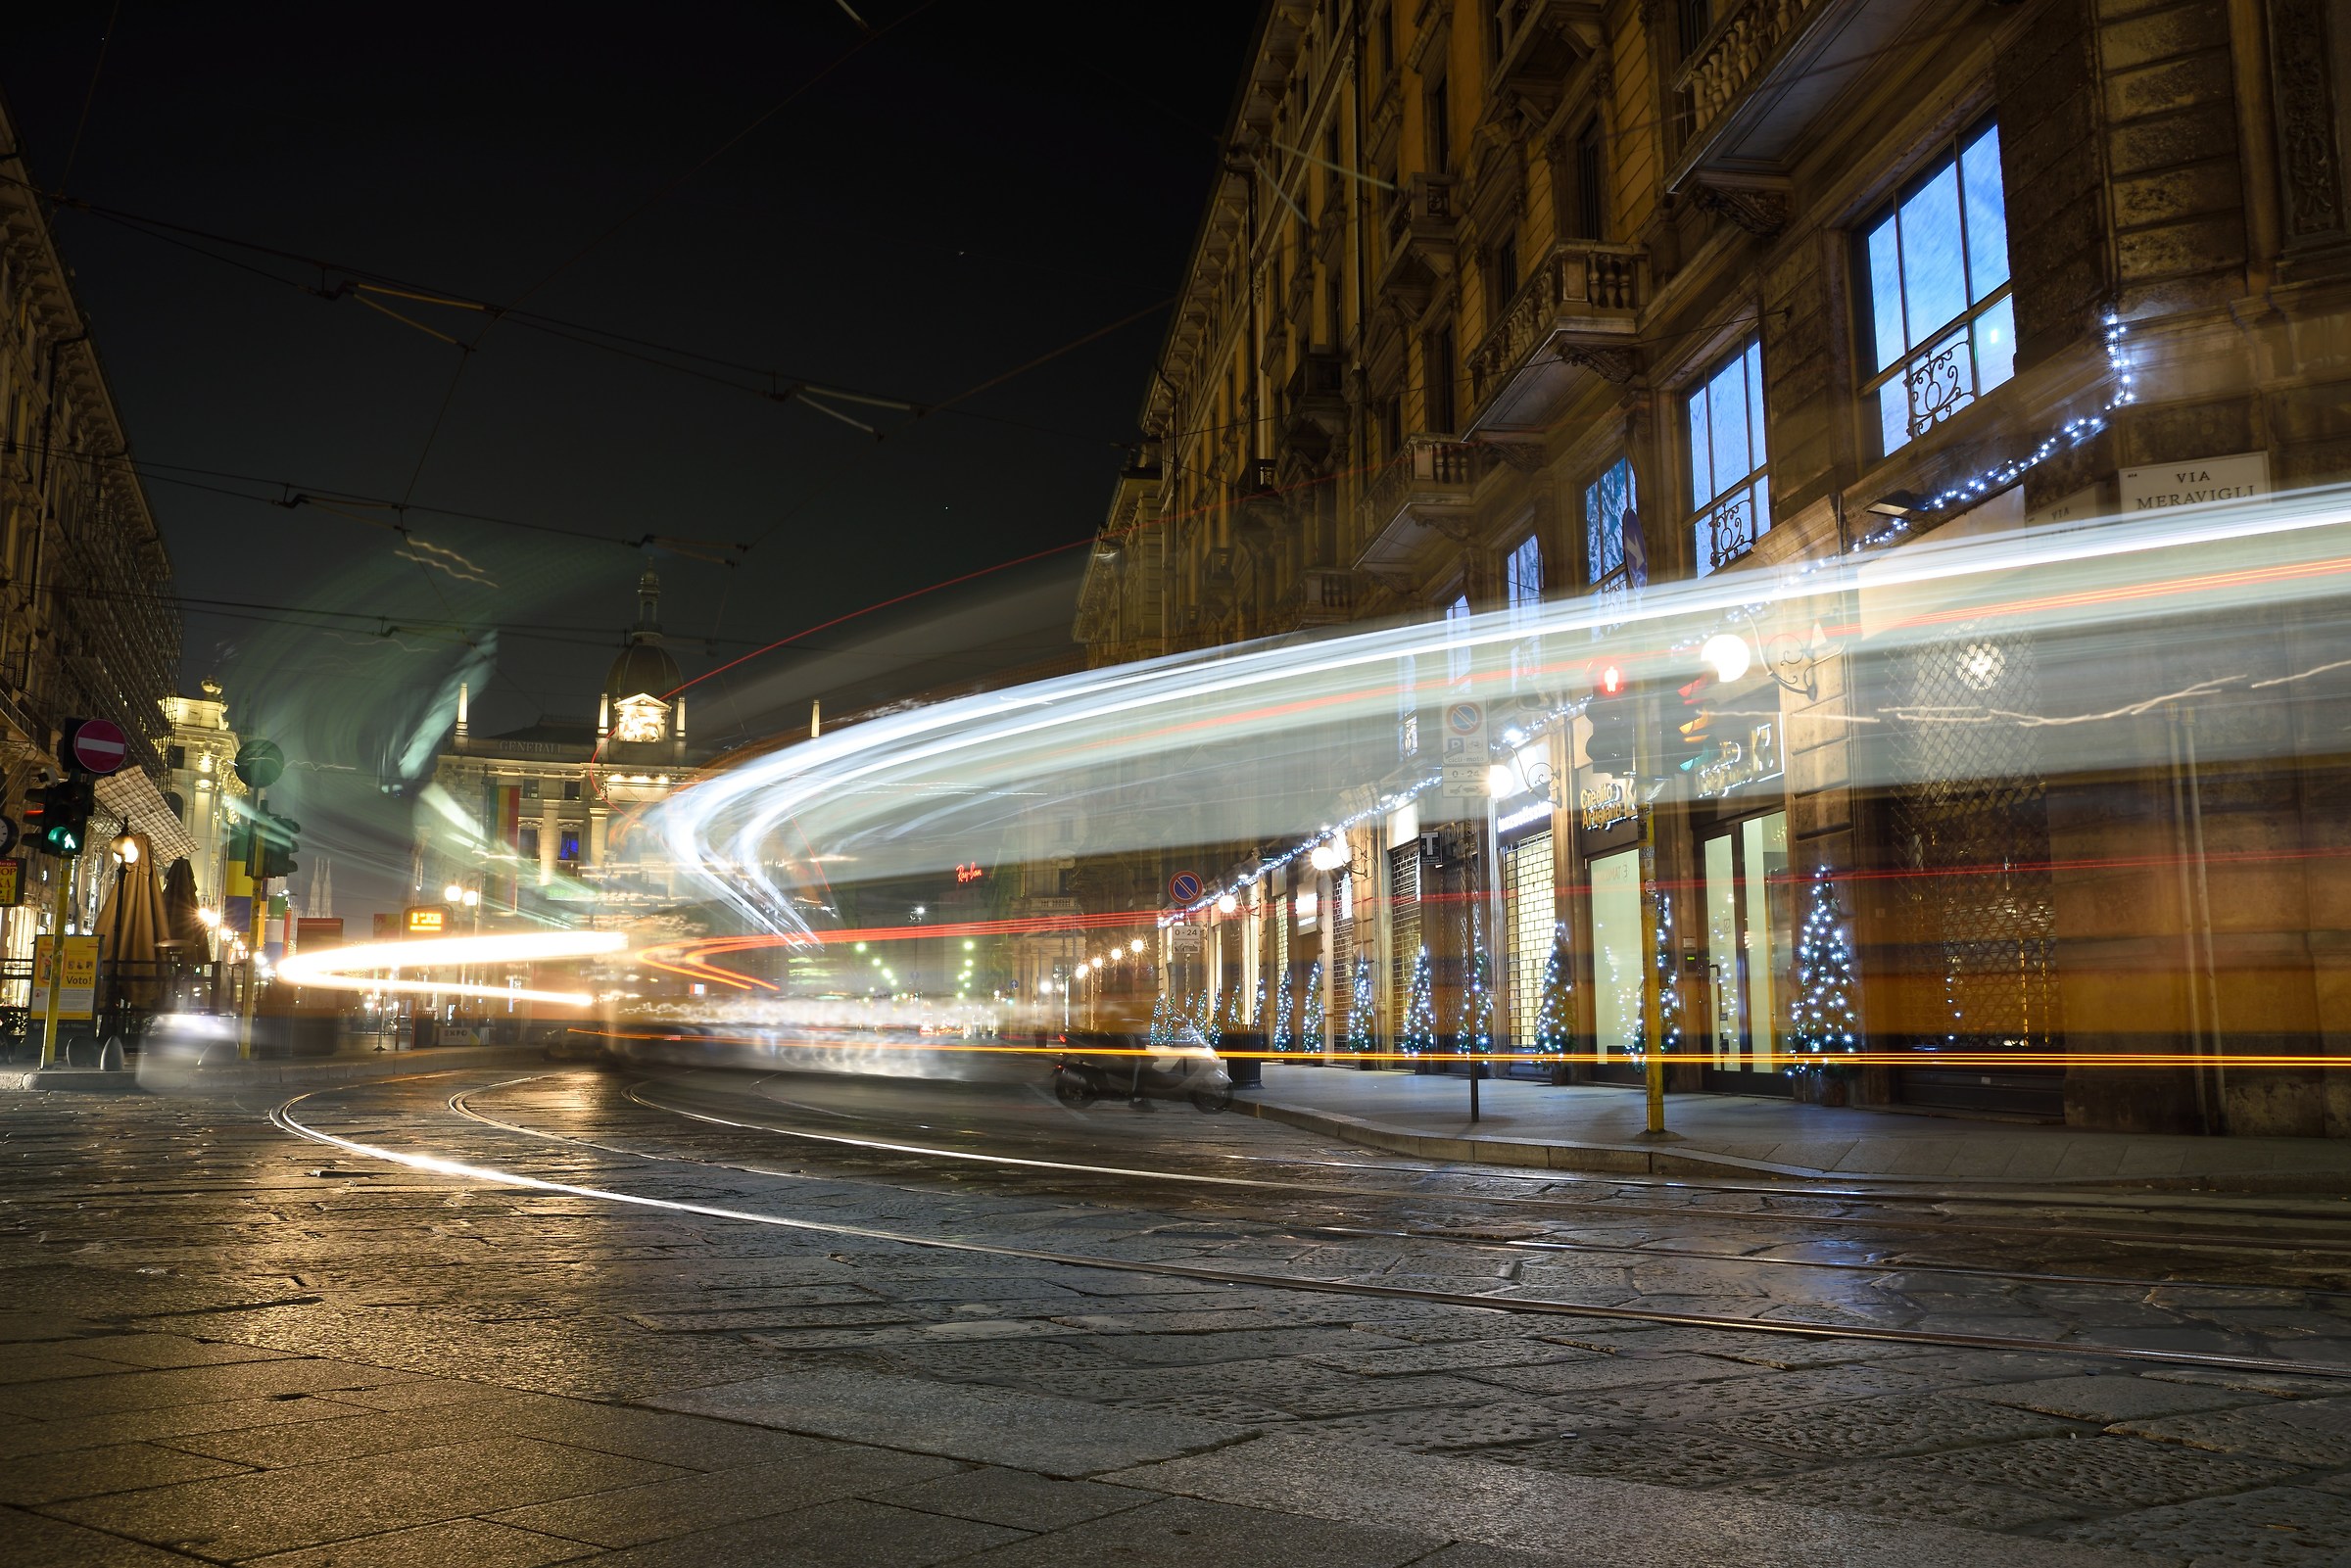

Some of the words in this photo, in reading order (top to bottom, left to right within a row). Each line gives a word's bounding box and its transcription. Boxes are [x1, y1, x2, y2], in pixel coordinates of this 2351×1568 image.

[2177, 471, 2211, 484] VIA
[2136, 485, 2255, 509] MERAVIGLI
[500, 740, 561, 753] GENERALI
[1580, 783, 1612, 810] Credito
[1582, 801, 1621, 830] Artigiano
[1420, 832, 1439, 856] T
[66, 975, 92, 985] Voto!
